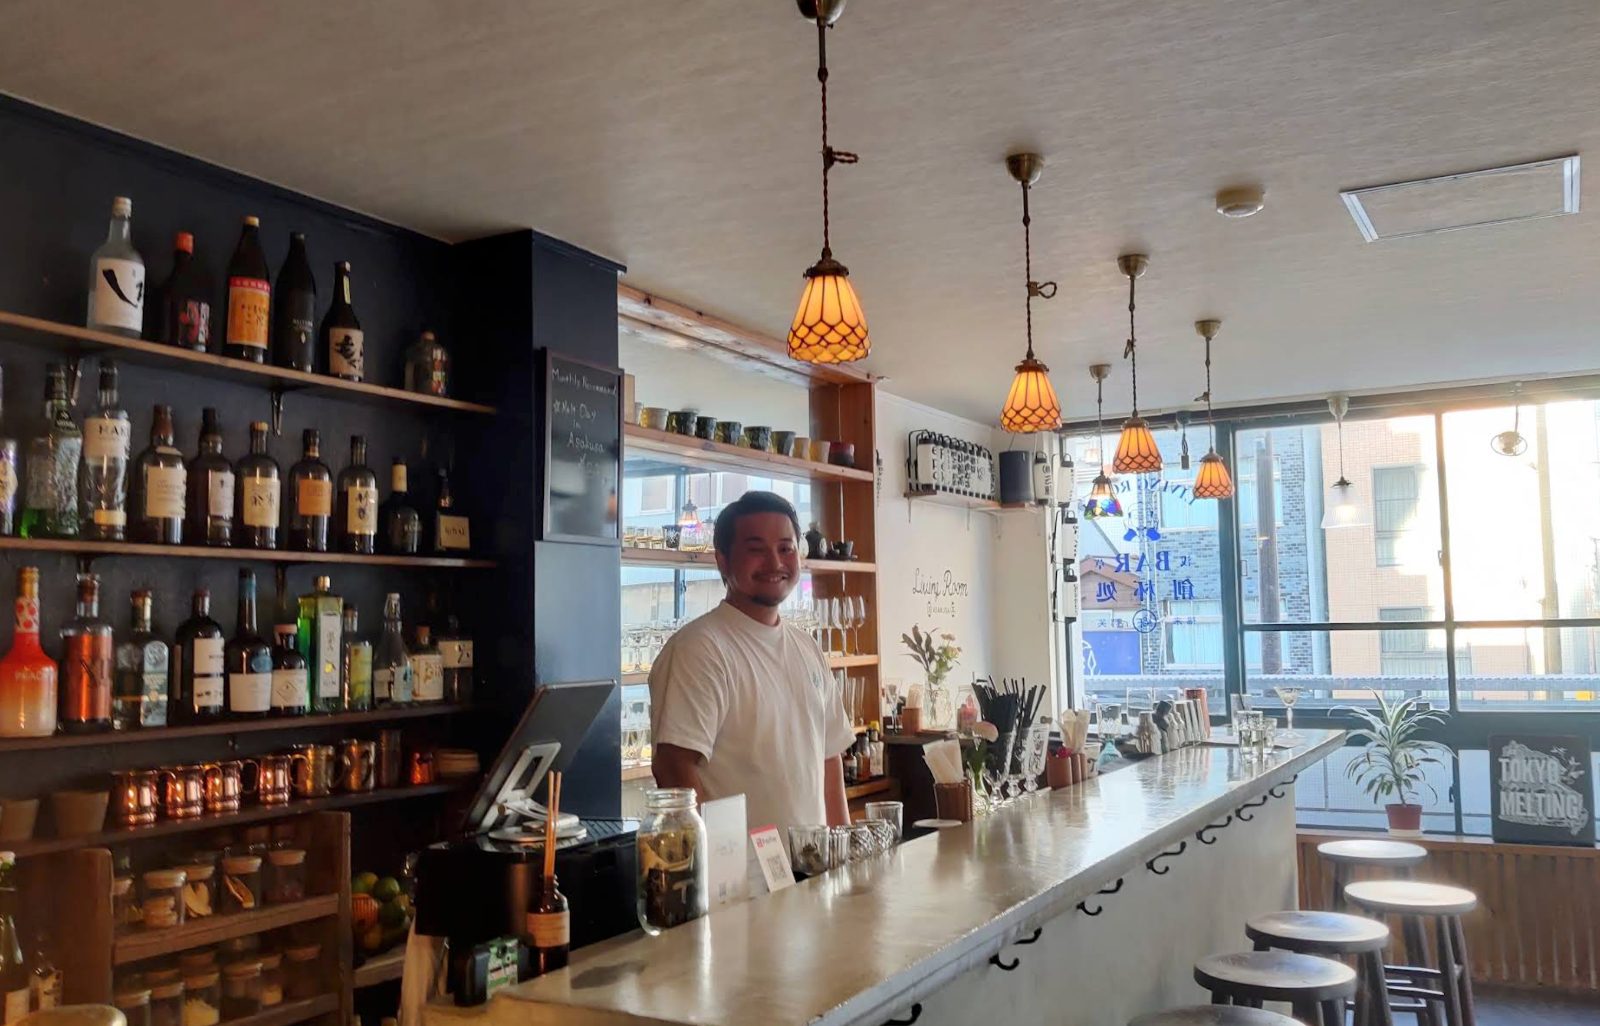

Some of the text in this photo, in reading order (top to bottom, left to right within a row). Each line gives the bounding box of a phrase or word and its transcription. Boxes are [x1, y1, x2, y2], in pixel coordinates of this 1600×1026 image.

[912, 568, 968, 600] Living Room
[1498, 758, 1559, 784] TOKYO
[1500, 792, 1578, 819] MELTING
